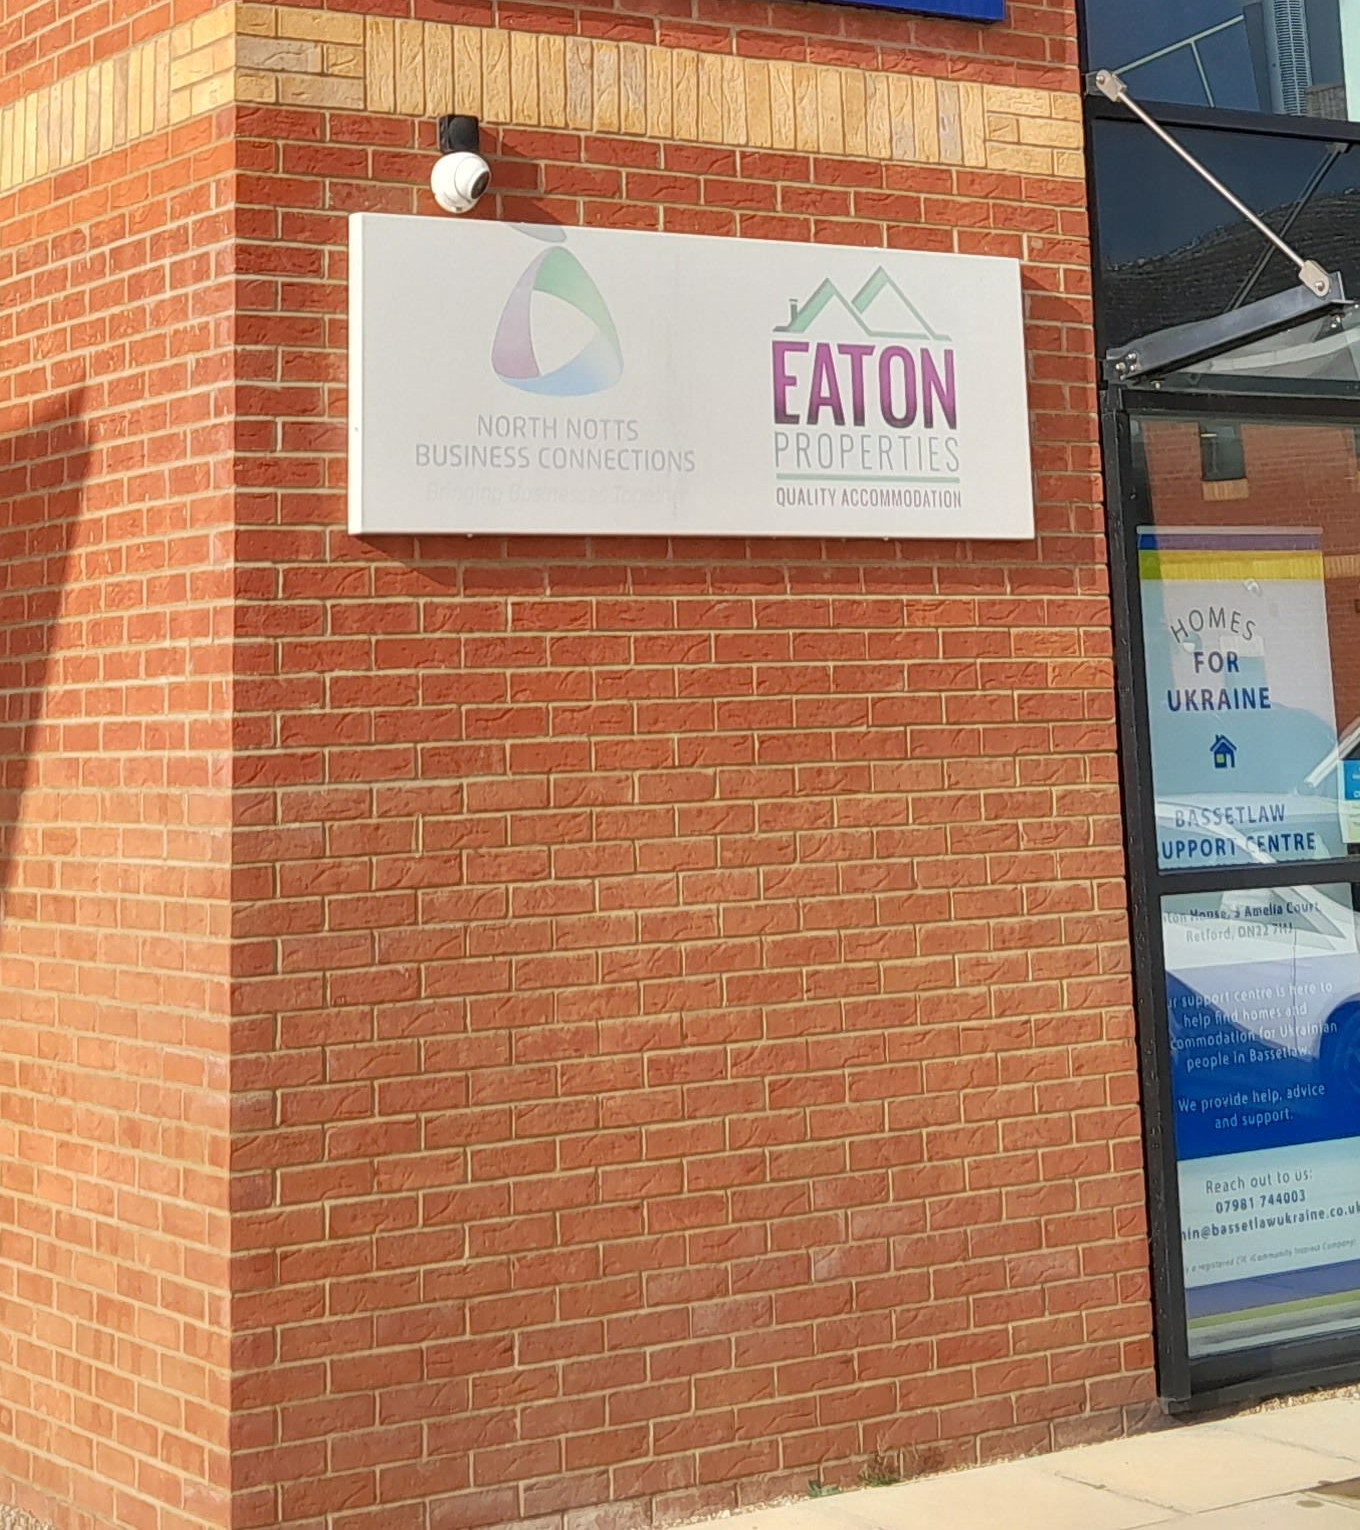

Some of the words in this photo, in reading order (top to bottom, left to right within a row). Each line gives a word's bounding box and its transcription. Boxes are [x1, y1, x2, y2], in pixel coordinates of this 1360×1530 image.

[771, 340, 958, 430] EATON
[477, 414, 558, 441] NORTH
[567, 418, 639, 441] NOTTS
[415, 444, 529, 470] BUSINESS
[538, 446, 695, 473] CONNECTIONS
[774, 431, 960, 472] PROPERTIES
[776, 486, 836, 507] QUALITY
[841, 488, 961, 509] ACCOMMODATION
[1171, 606, 1256, 643] HOMES
[1194, 651, 1240, 674] FOR
[1167, 687, 1271, 712] UKRAINE
[1175, 804, 1285, 828] BASSETLAW
[1162, 838, 1236, 859] UPPORT
[1244, 902, 1283, 918] Amelia
[1181, 992, 1230, 1009] support
[1234, 987, 1273, 1002] centre
[1276, 986, 1285, 997] is
[1289, 982, 1317, 996] here
[1320, 981, 1333, 992] to
[1183, 1014, 1211, 1030] help
[1215, 1009, 1238, 1025] find
[1242, 1006, 1282, 1021] homes
[1285, 1002, 1308, 1018] and
[1170, 1030, 1256, 1050] commodation
[1259, 1028, 1276, 1041] for
[1279, 1021, 1338, 1038] Ukrainian
[1186, 1053, 1229, 1073] people
[1233, 1051, 1246, 1064] in
[1178, 1098, 1197, 1113] We
[1201, 1092, 1248, 1114] provide
[1287, 1083, 1326, 1100] advice
[1214, 1113, 1238, 1129] and
[1242, 1107, 1294, 1129] support.
[1206, 1176, 1245, 1195] Reach
[1250, 1173, 1272, 1188] out
[1277, 1170, 1290, 1184] to
[1216, 1196, 1255, 1214] 07981
[1260, 1189, 1306, 1208] 744003
